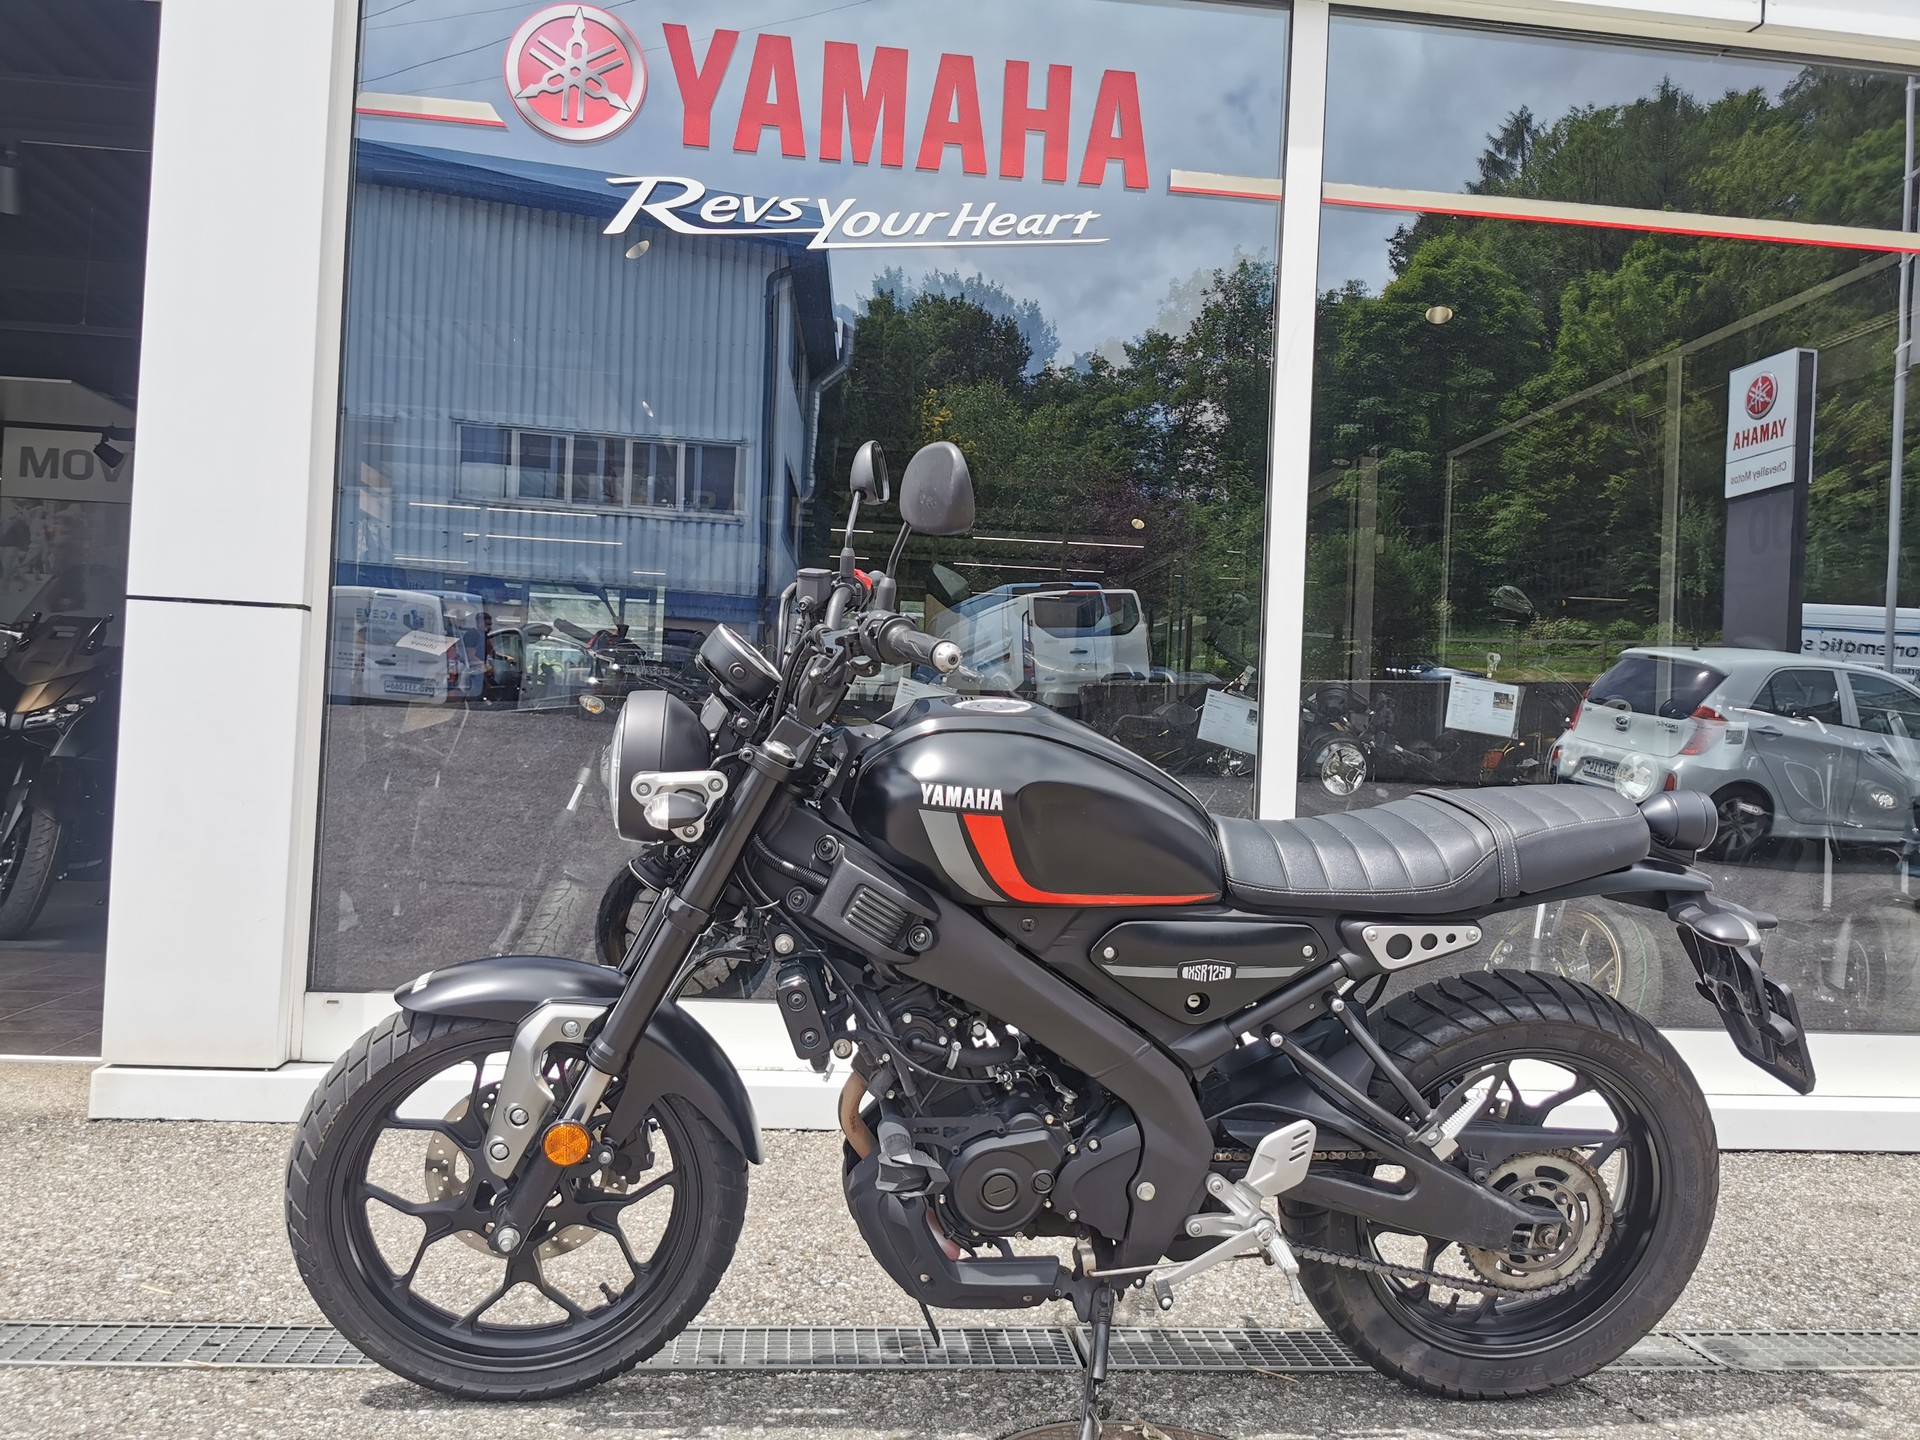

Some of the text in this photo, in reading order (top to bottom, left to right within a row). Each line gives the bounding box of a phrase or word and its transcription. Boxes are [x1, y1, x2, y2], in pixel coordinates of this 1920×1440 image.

[661, 23, 1149, 190] YAMAHA
[947, 201, 1101, 239] Heart
[20, 447, 132, 482] MOV
[920, 783, 1003, 811] YAMAHA
[1187, 964, 1226, 983] XSR125
